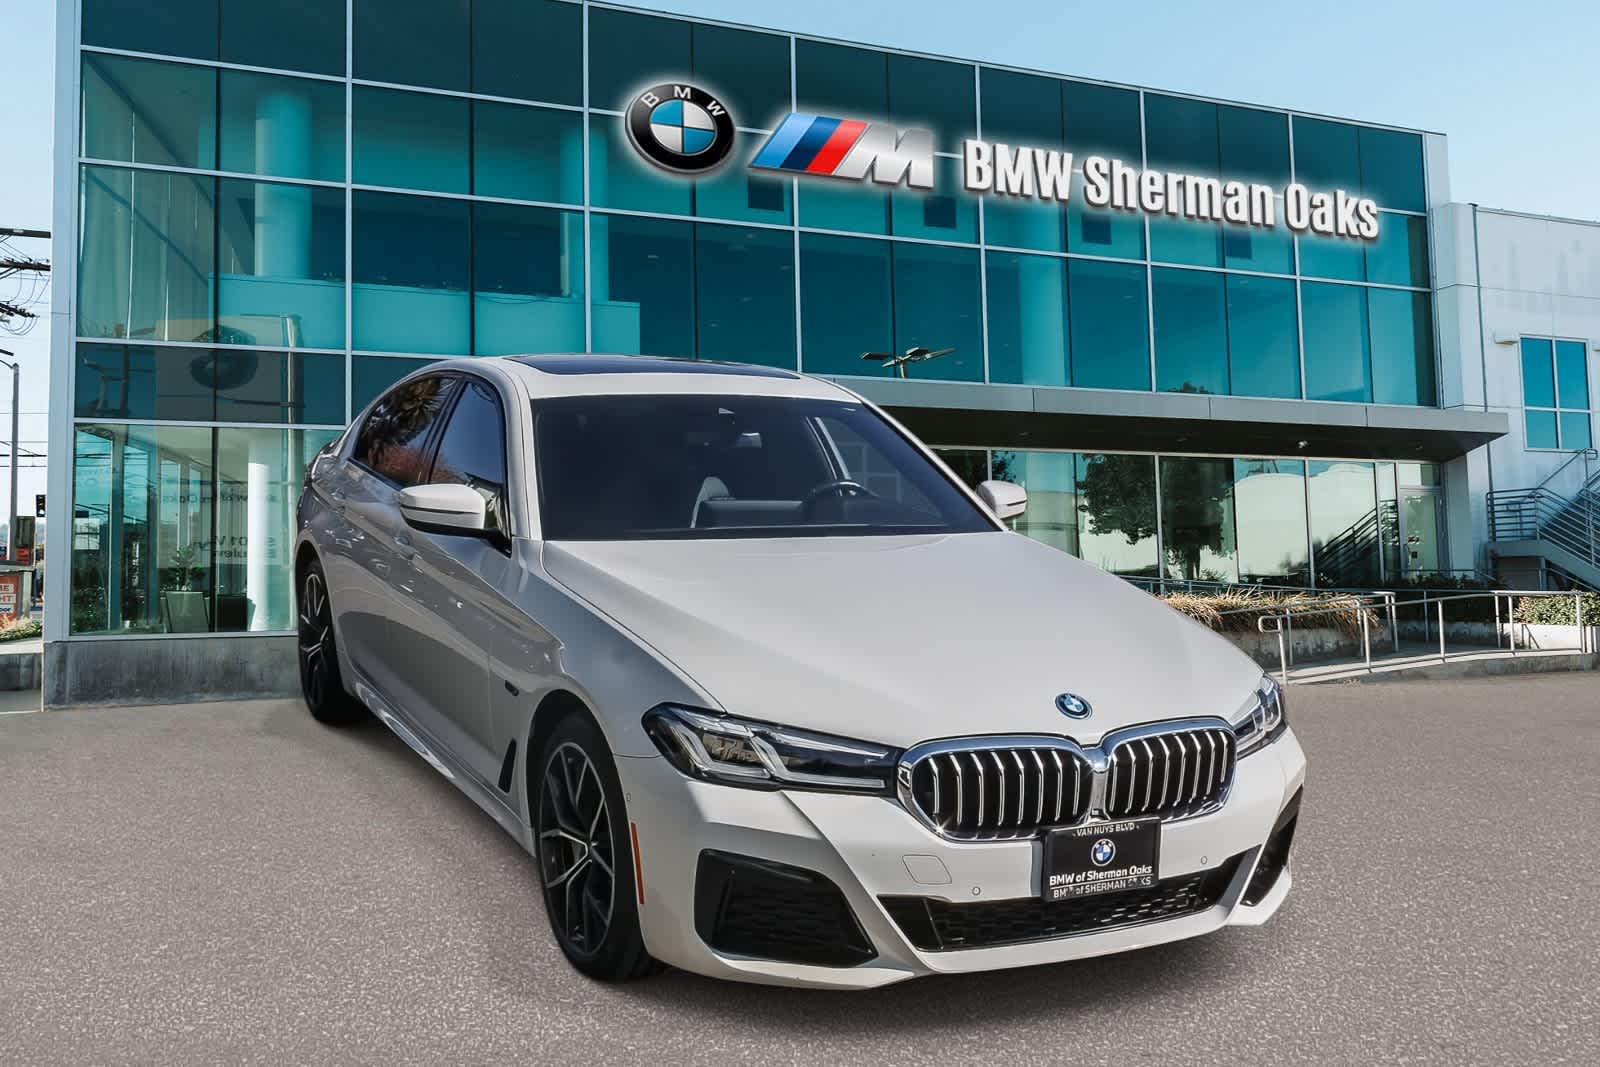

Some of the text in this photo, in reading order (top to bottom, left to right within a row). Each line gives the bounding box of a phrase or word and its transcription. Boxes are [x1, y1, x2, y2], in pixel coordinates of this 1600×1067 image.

[641, 85, 725, 117] BMW
[963, 139, 1380, 240] BMW Sherman Oaks
[1076, 828, 1092, 837] VAN
[1116, 822, 1135, 832] BLVD
[1049, 865, 1153, 886] BMW of Sherman Oaks
[1085, 880, 1126, 894] SHERMAN
